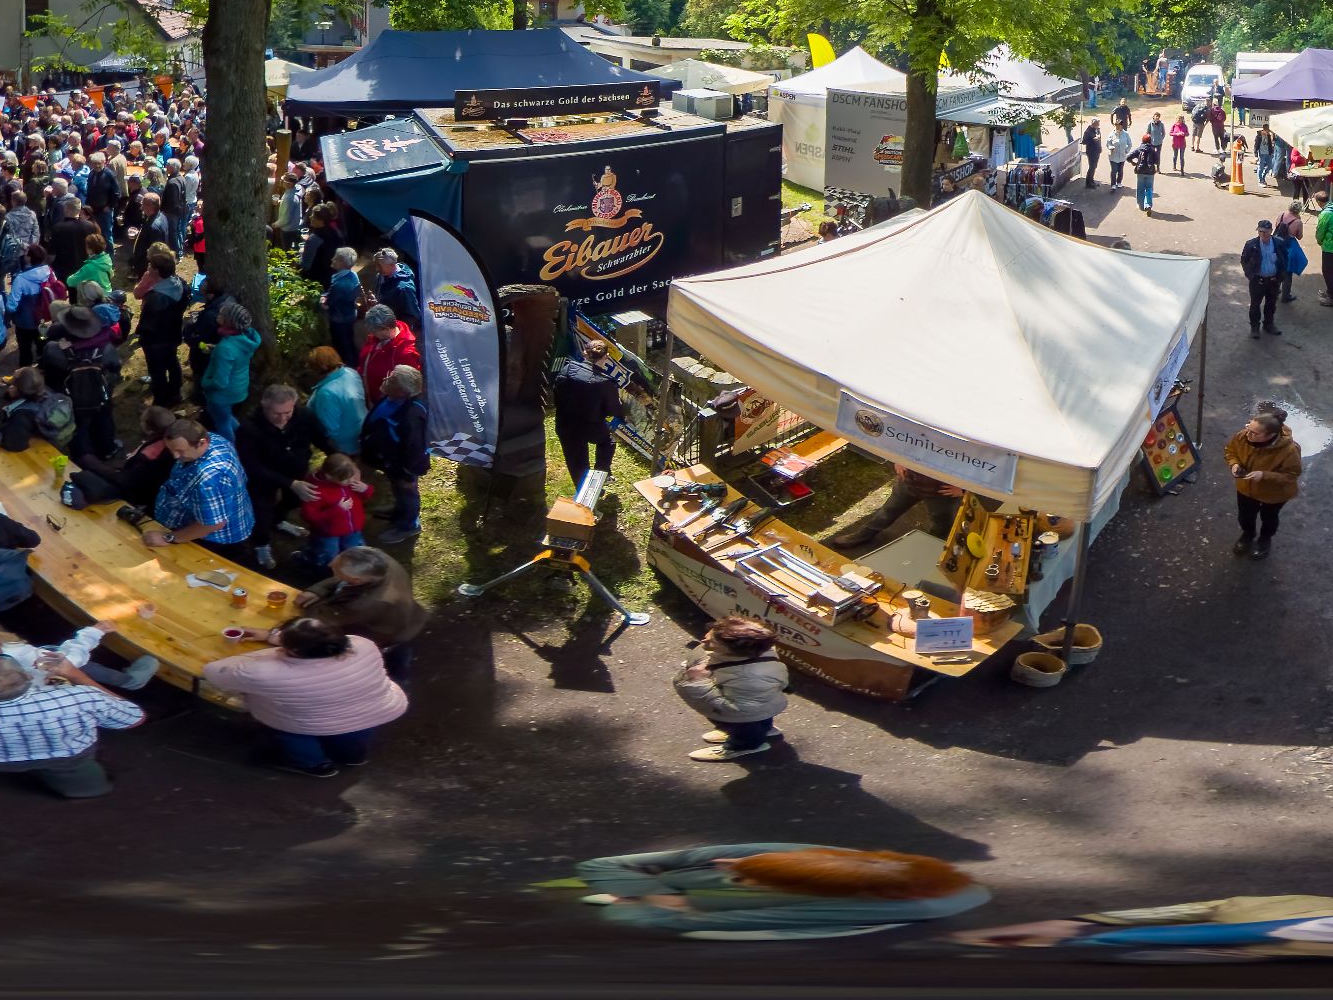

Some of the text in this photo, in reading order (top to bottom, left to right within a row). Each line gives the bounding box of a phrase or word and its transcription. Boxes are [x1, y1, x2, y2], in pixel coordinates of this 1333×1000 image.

[493, 93, 630, 110] Das schwarze Gold der Sachsen
[779, 91, 796, 101] ASPEN
[832, 93, 907, 112] DSCM FANSHO
[948, 90, 976, 108] FANSHOP
[831, 144, 856, 155] STIHL
[539, 221, 654, 281] Eibauer
[596, 244, 653, 274] Schwarzbier
[595, 287, 625, 302] Gold
[629, 283, 649, 296] der
[885, 425, 999, 474] Schnitzerherz
